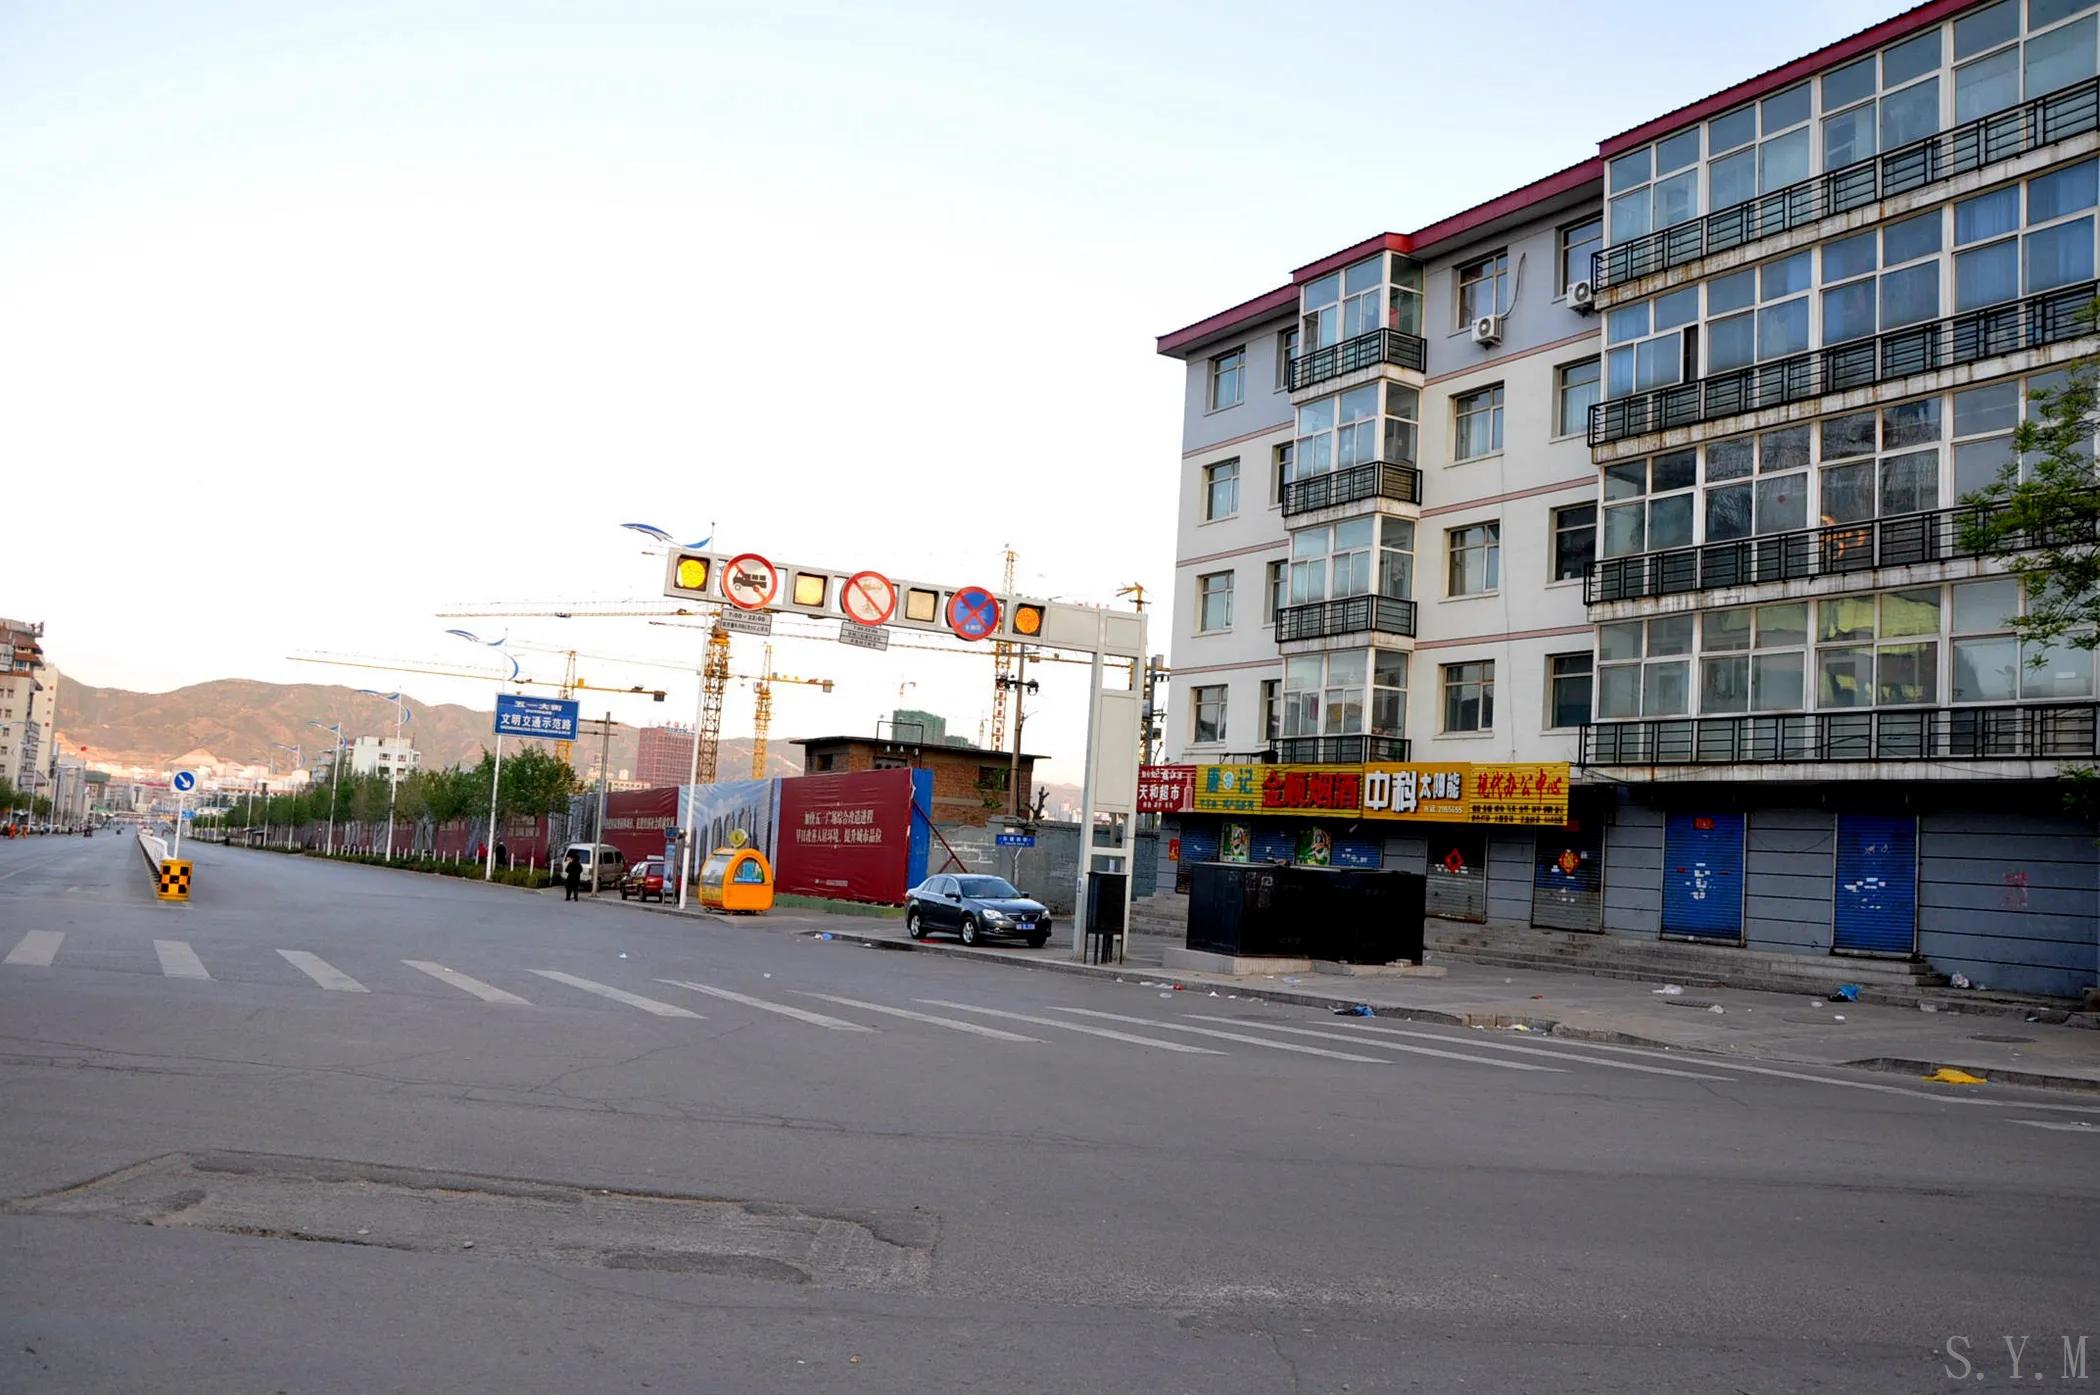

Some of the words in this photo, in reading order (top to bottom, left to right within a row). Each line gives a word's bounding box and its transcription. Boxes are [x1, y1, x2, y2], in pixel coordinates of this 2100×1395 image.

[513, 700, 563, 712] 五一大街
[500, 712, 572, 730] 文明交通示范路
[1138, 784, 1181, 801] 天和超市
[1364, 770, 1417, 813] 中科
[1418, 772, 1462, 800] 太阳能
